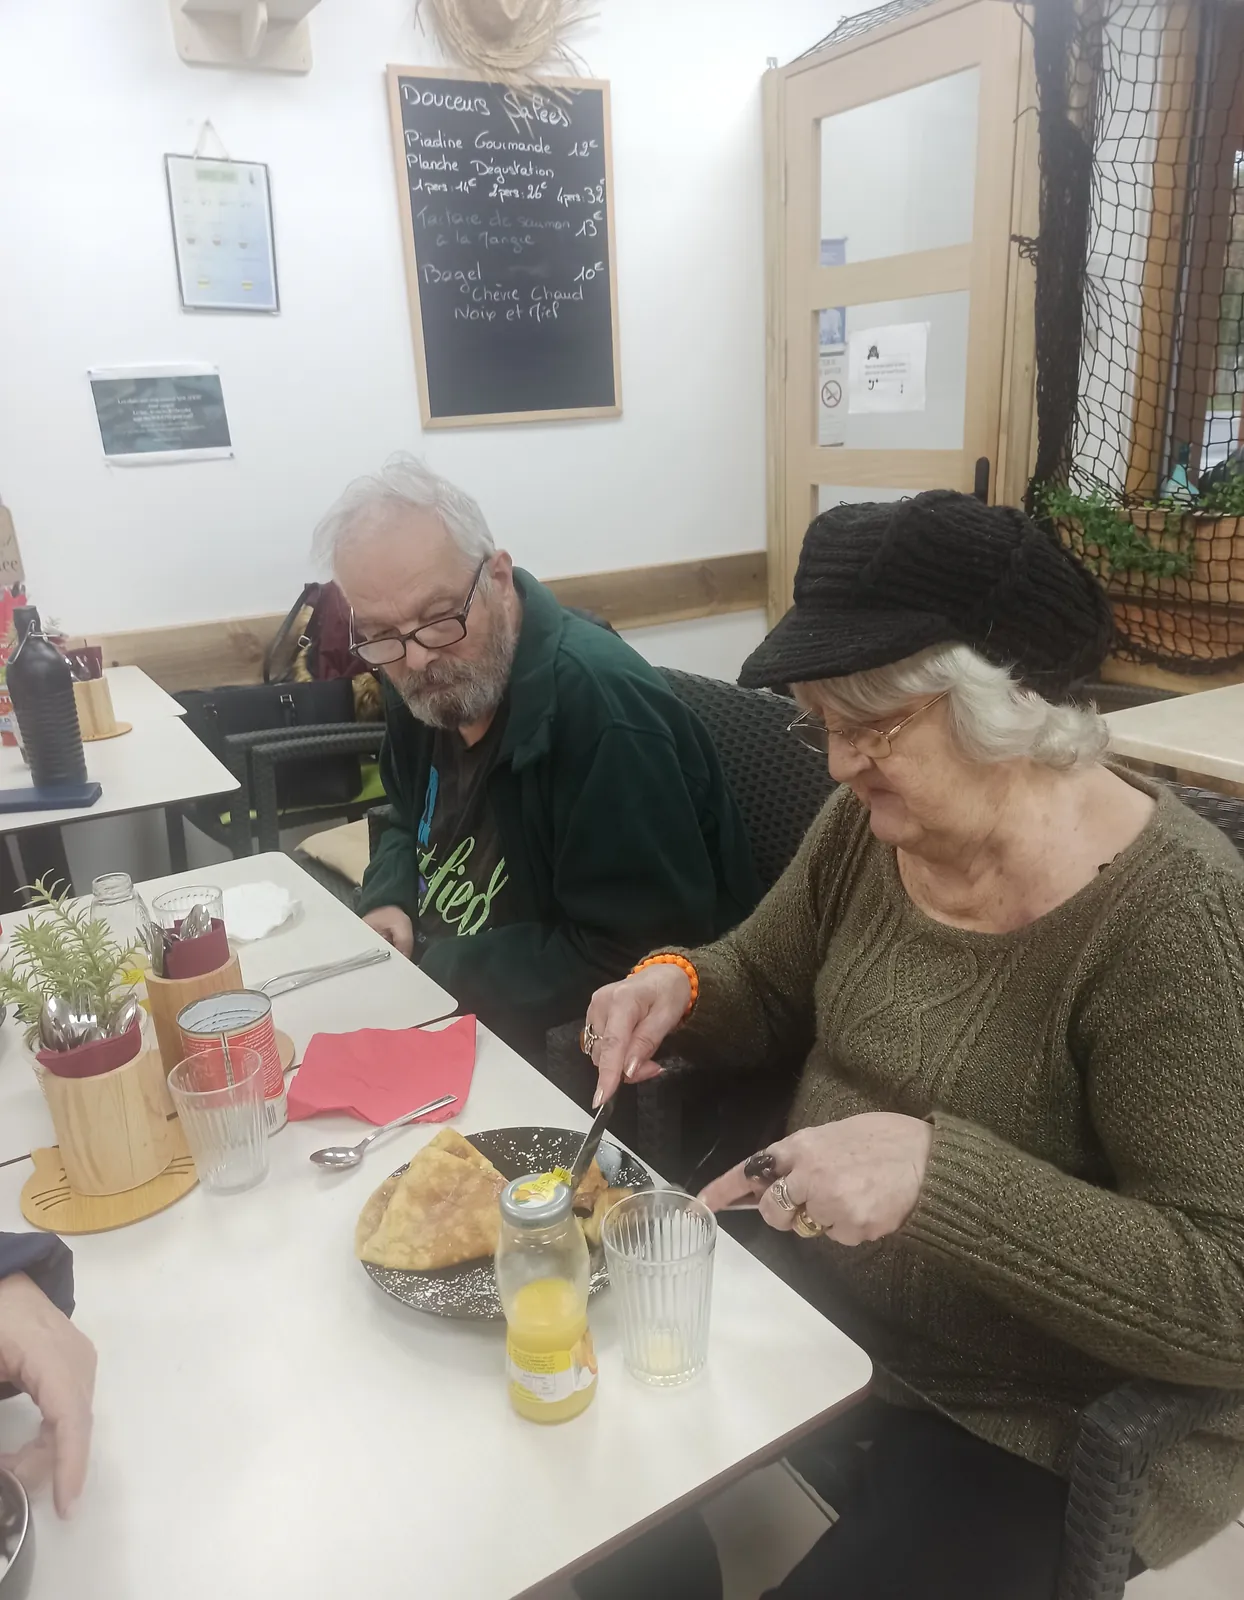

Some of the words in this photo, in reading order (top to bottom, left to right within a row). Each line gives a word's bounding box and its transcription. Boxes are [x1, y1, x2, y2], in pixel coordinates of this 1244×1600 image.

[401, 84, 491, 116] Douceurs
[404, 129, 463, 149] Piadine
[474, 130, 552, 155] Gourmande
[406, 153, 460, 172] Planche
[469, 157, 555, 184] Dégustation
[488, 209, 513, 228] de
[516, 216, 571, 230] saumon
[455, 230, 472, 245] la
[421, 261, 483, 294] Bagel
[472, 283, 520, 302] Chèvre
[530, 285, 584, 301] Chaud
[505, 303, 524, 321] et
